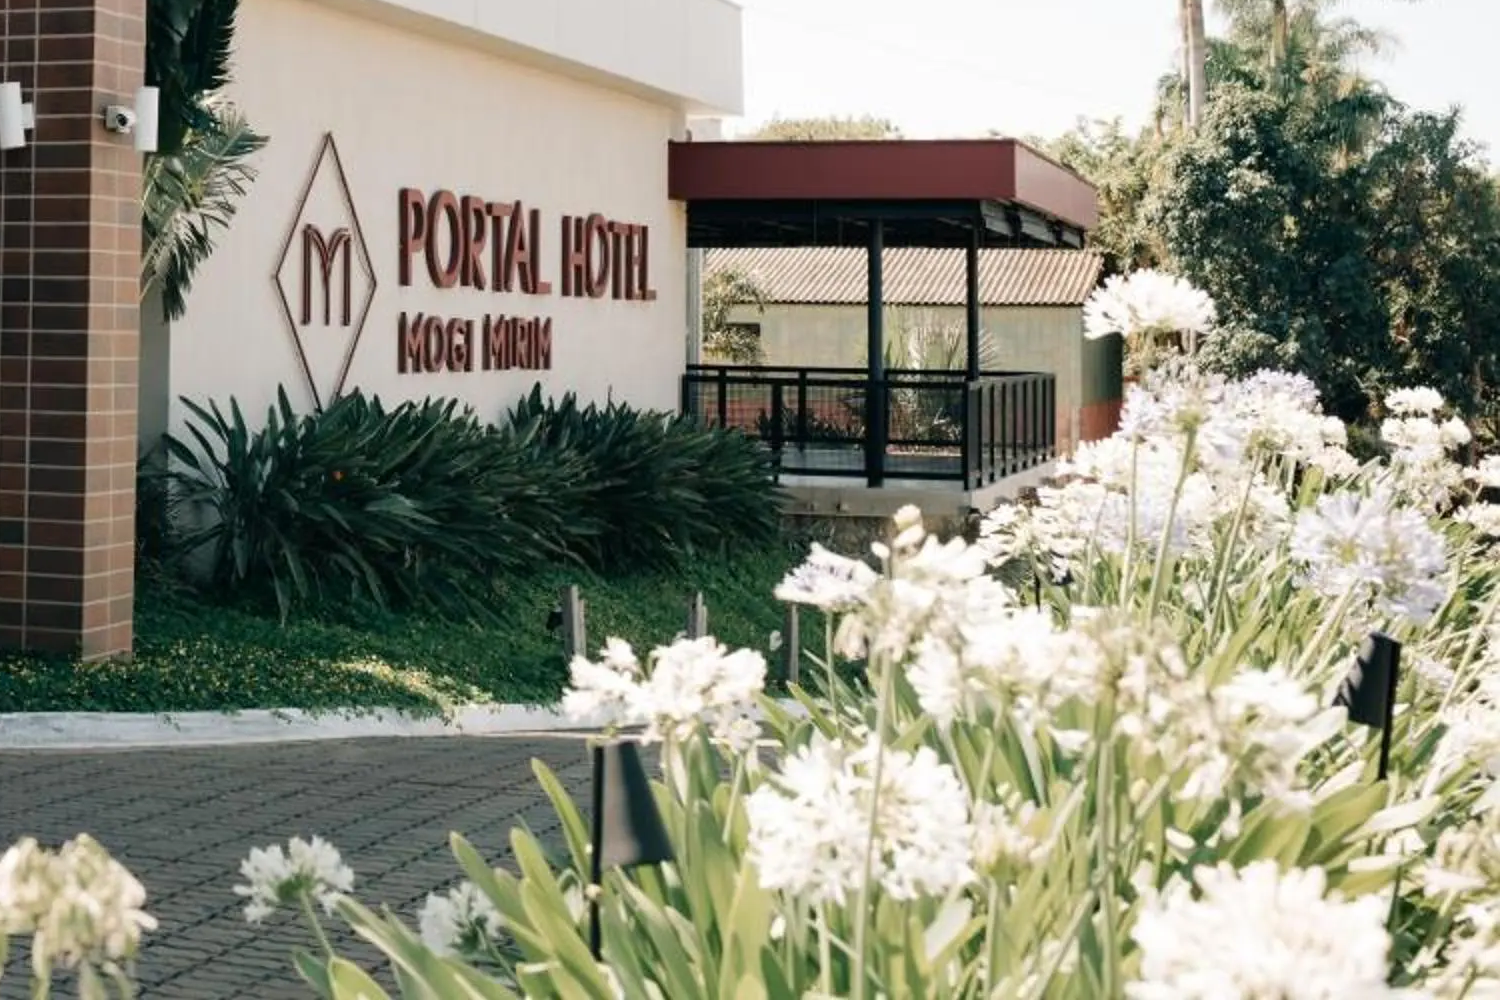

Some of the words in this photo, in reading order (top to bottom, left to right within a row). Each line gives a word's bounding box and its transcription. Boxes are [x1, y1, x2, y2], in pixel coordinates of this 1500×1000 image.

[398, 187, 552, 295] PORTAL
[561, 213, 657, 301] HOTEL
[397, 311, 474, 374] MOGI
[481, 313, 553, 371] MIRIM
